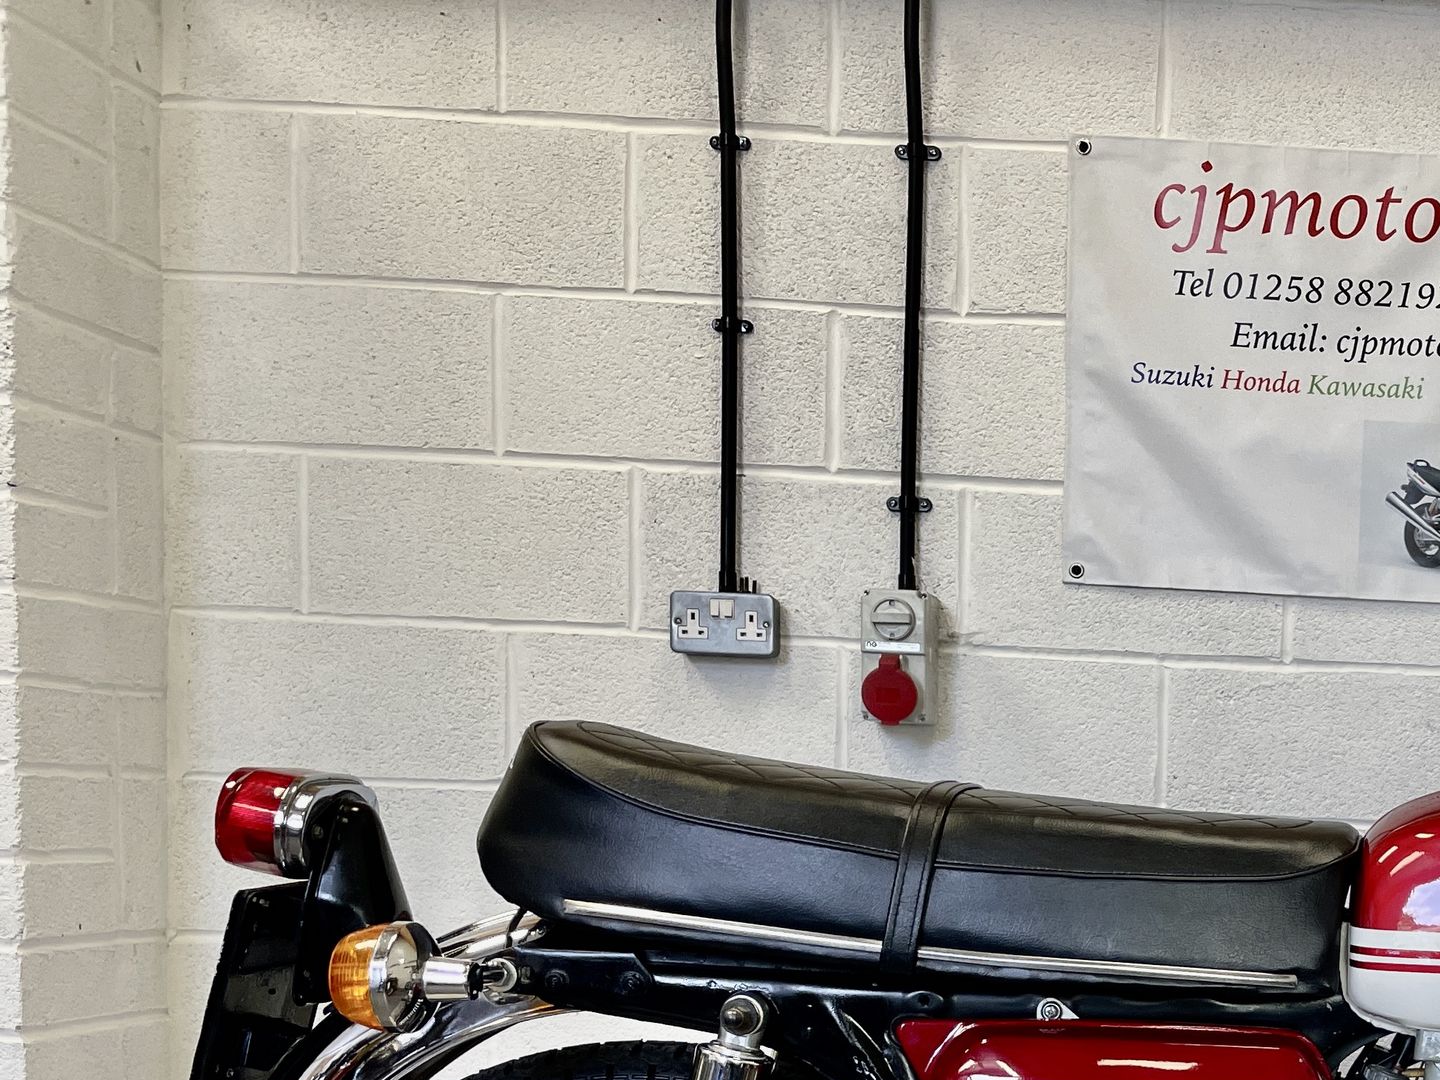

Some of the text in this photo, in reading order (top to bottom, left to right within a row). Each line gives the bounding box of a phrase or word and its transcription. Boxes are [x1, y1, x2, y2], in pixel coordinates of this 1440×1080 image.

[1173, 268, 1214, 297] Tel
[1223, 272, 1324, 303] 01258
[1230, 322, 1327, 352] Email:
[1131, 362, 1424, 399] Suzuki Honda Kawasaki
